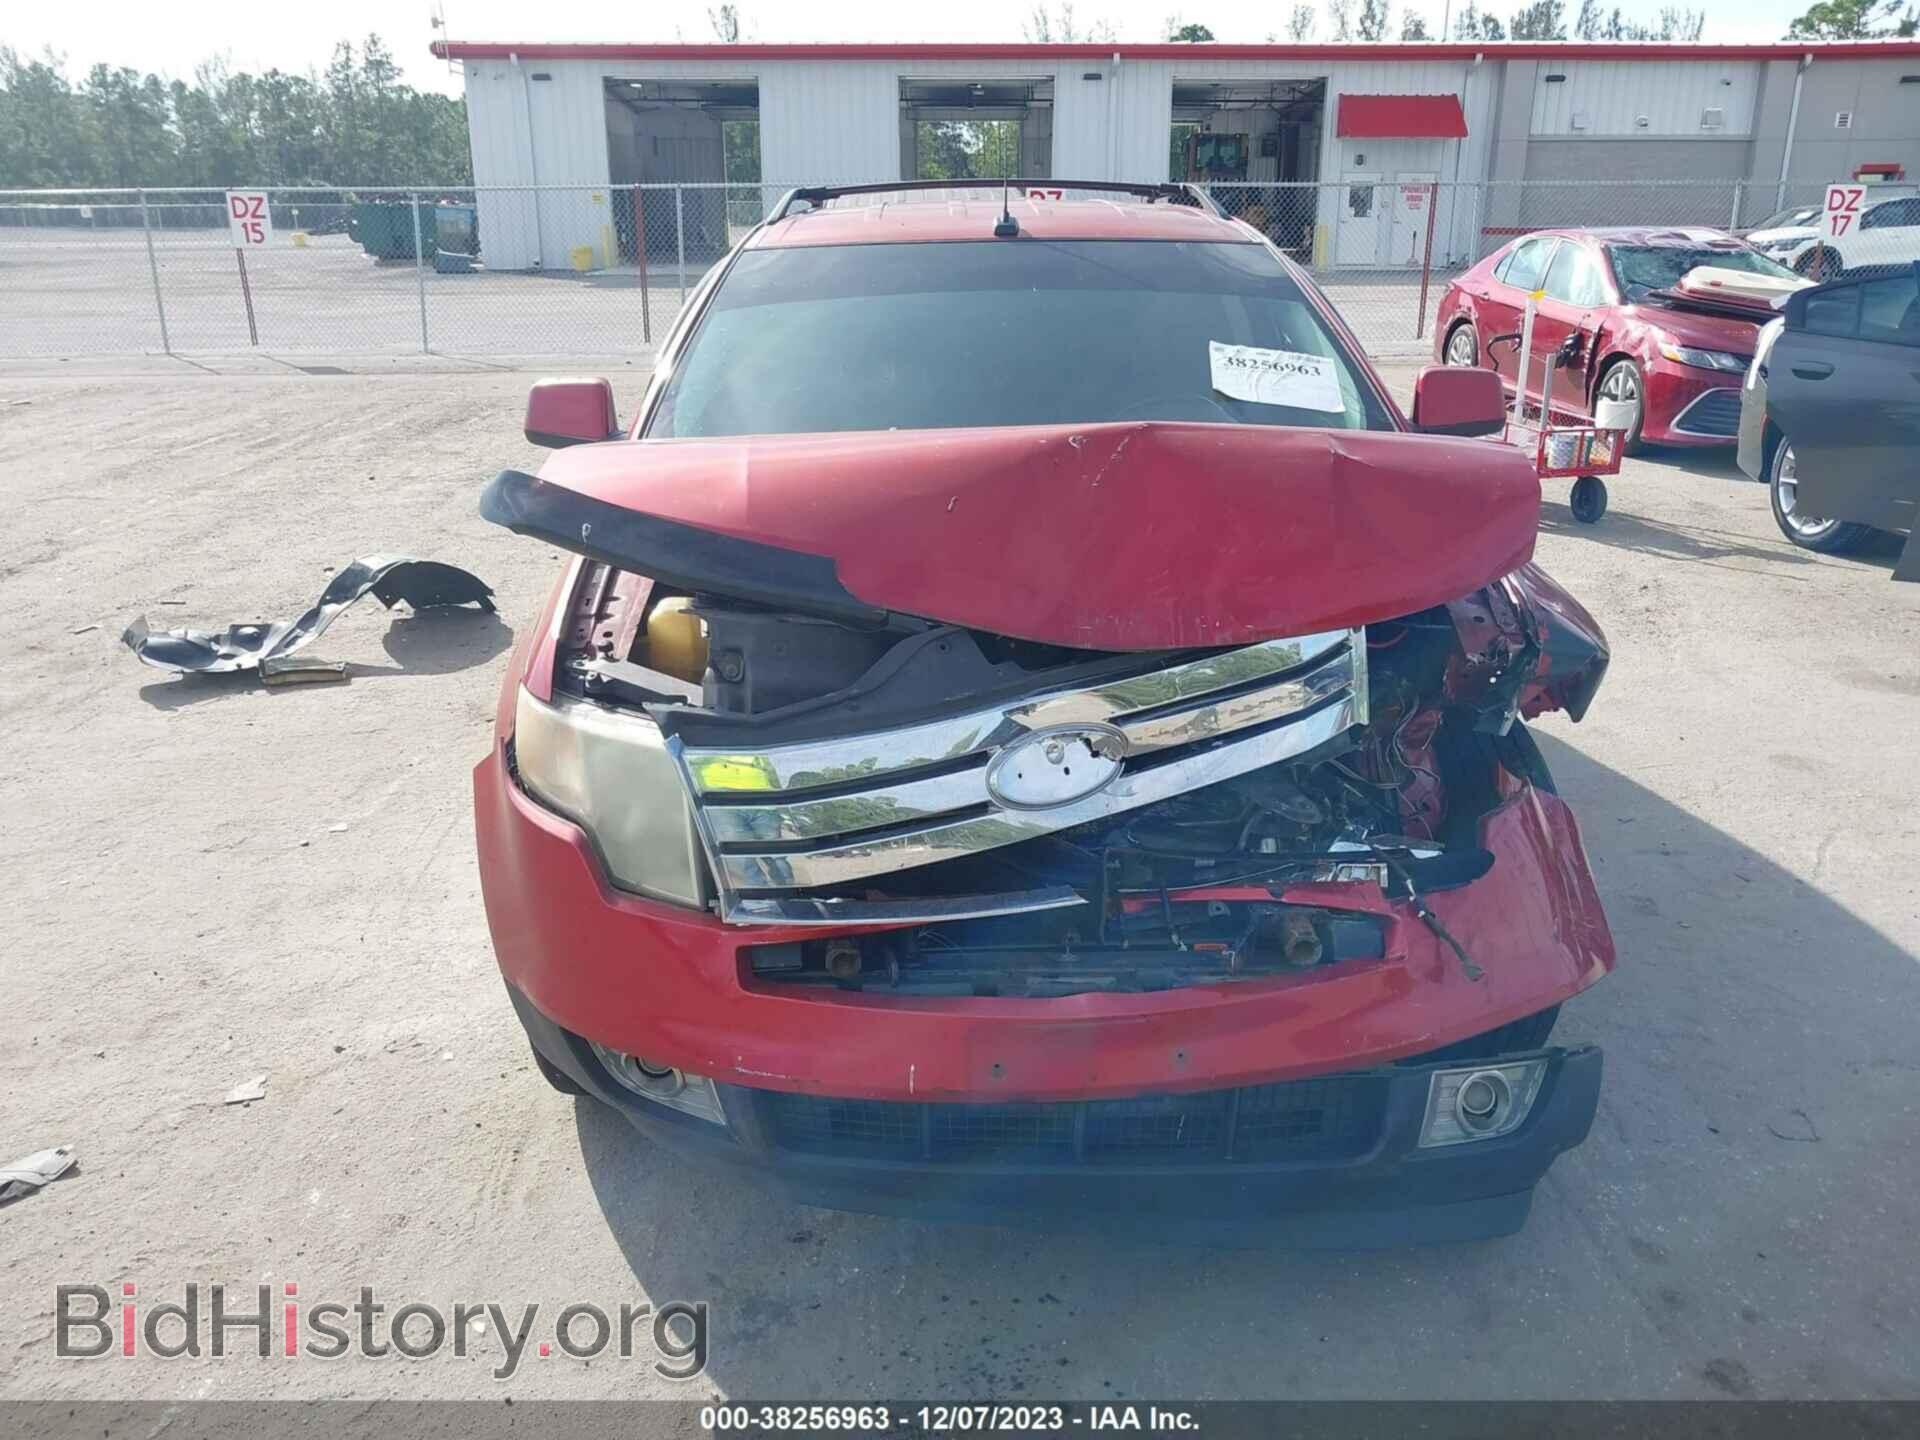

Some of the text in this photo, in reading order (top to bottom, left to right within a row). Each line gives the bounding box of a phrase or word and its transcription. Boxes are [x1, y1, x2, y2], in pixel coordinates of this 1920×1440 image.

[230, 196, 266, 219] DZ
[1828, 189, 1862, 211] DZ
[241, 222, 265, 244] 15
[1831, 215, 1852, 236] 17
[1224, 356, 1321, 377] 38256963
